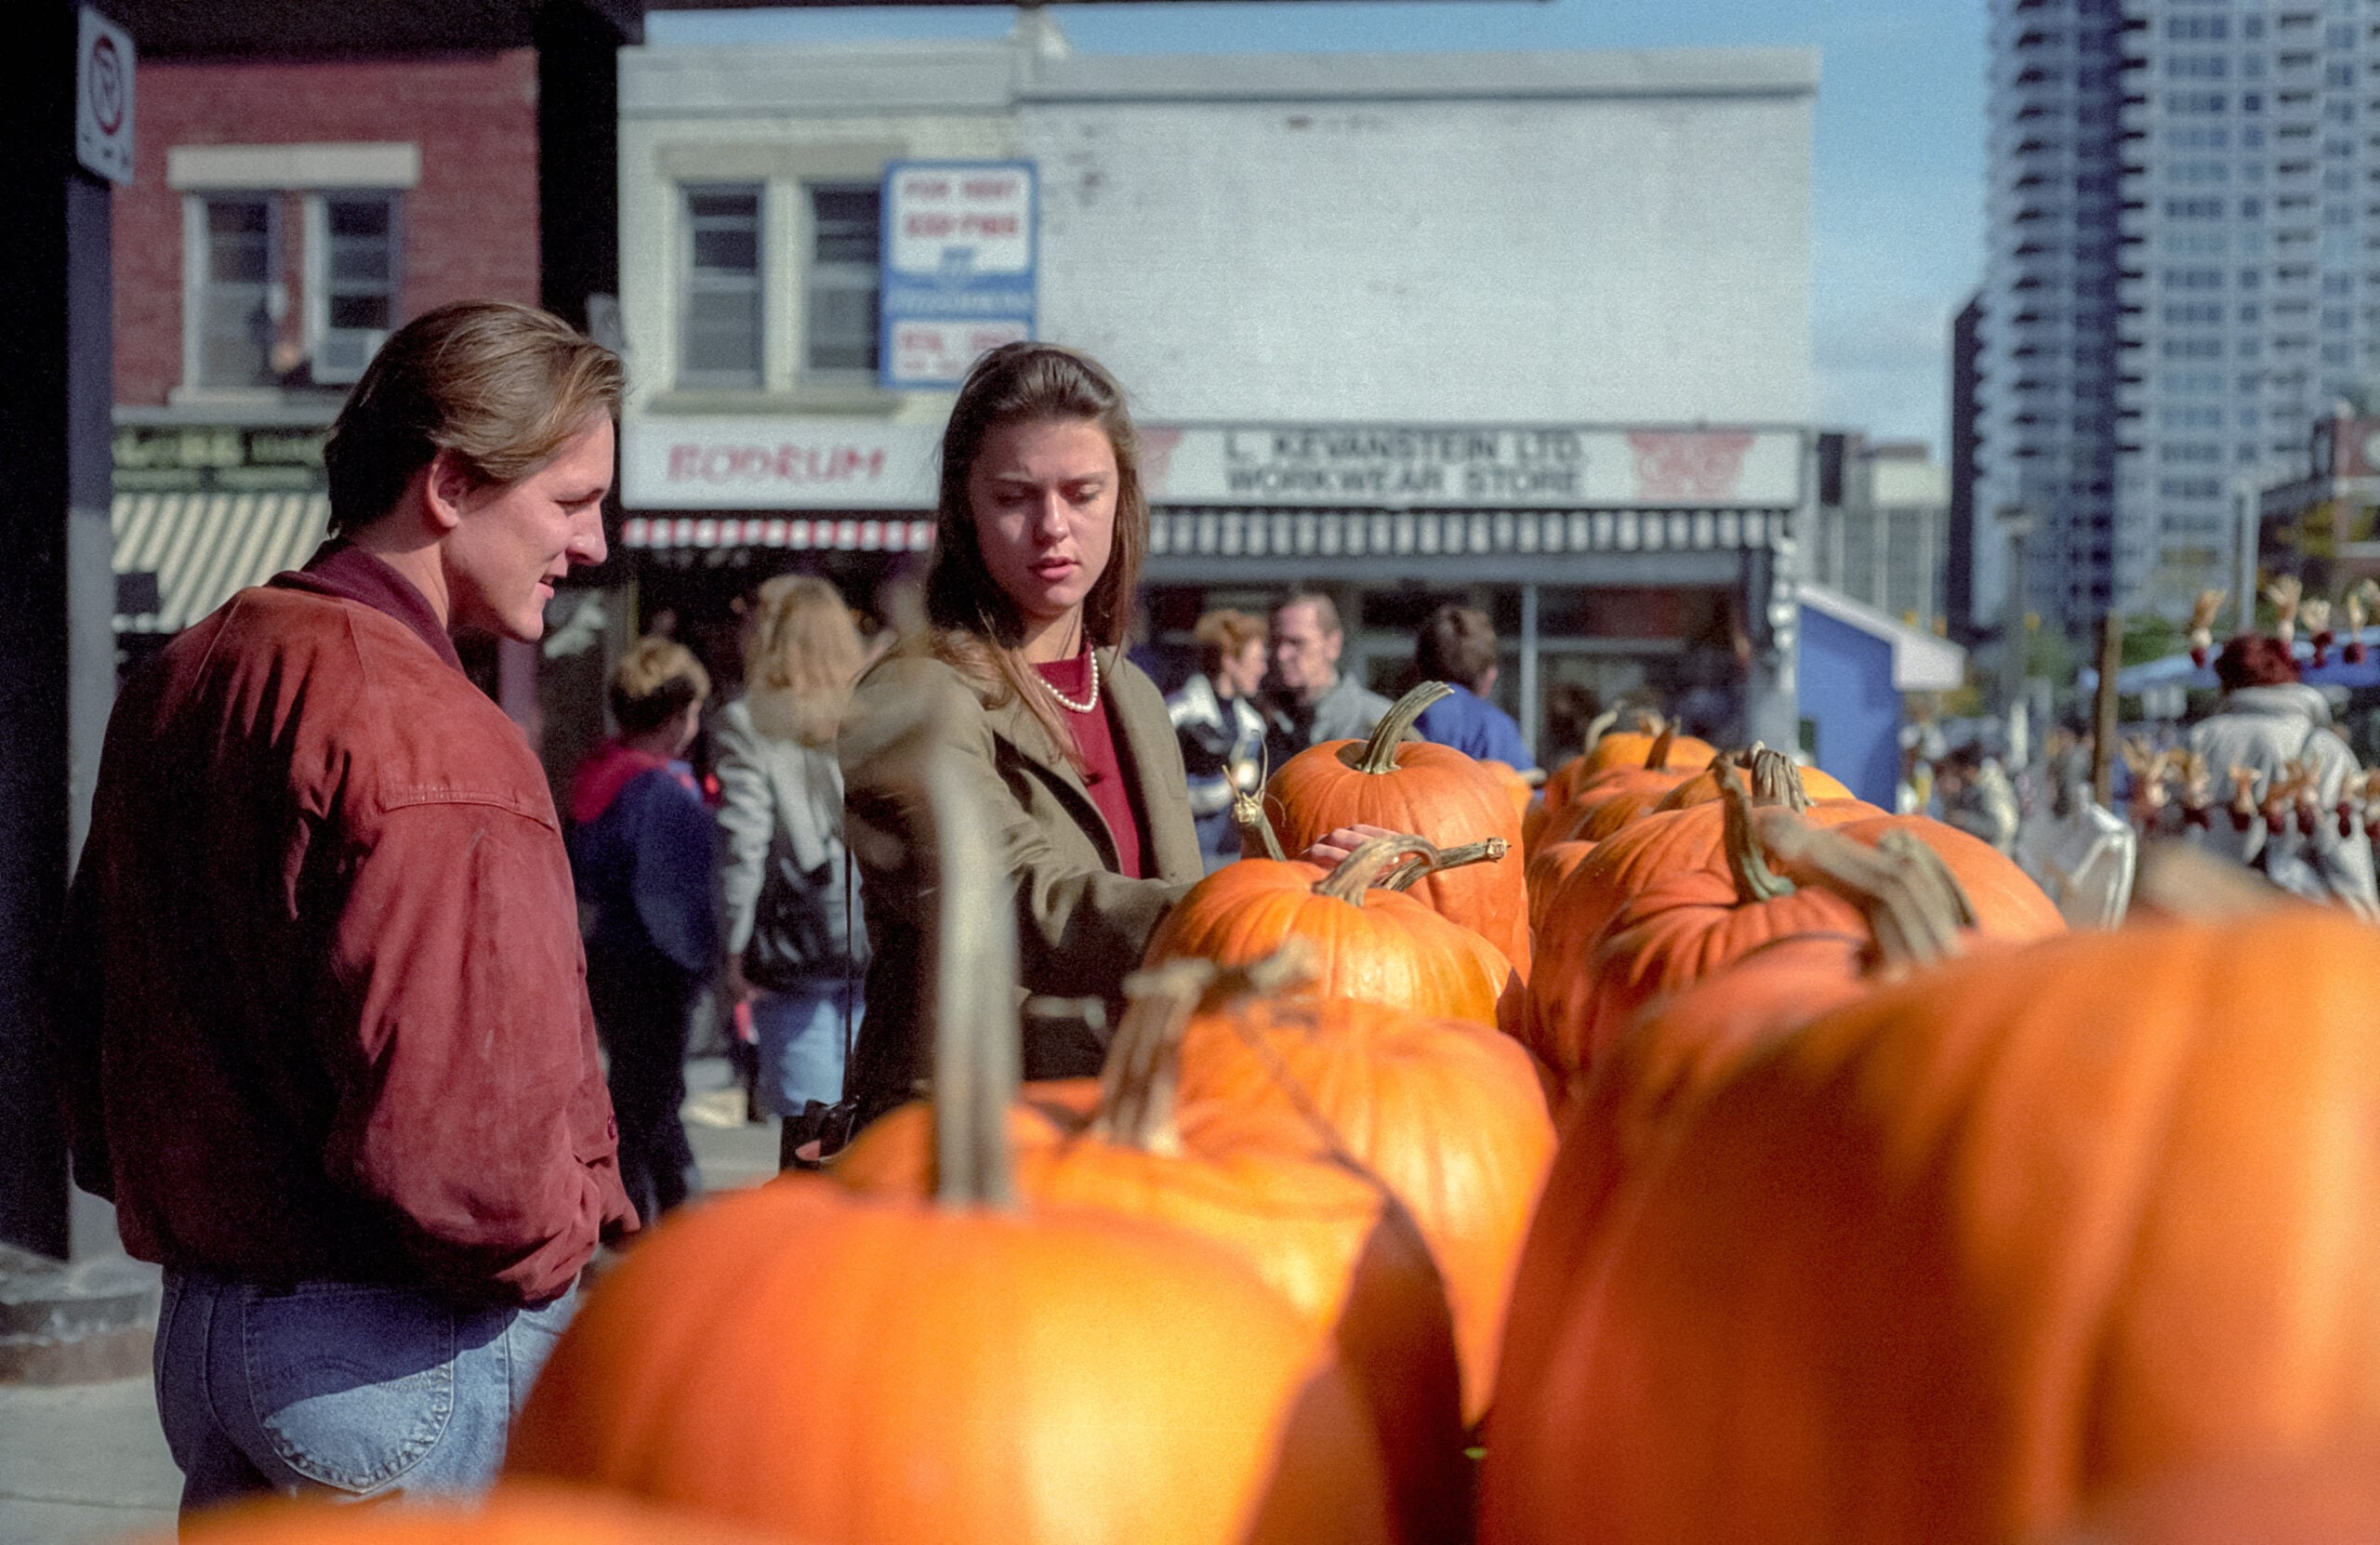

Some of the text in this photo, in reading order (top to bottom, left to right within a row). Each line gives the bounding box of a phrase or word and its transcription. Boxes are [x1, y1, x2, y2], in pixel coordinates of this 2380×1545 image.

[668, 442, 886, 487] BODRUM
[1227, 469, 1581, 495] WORKWEAR STORE
